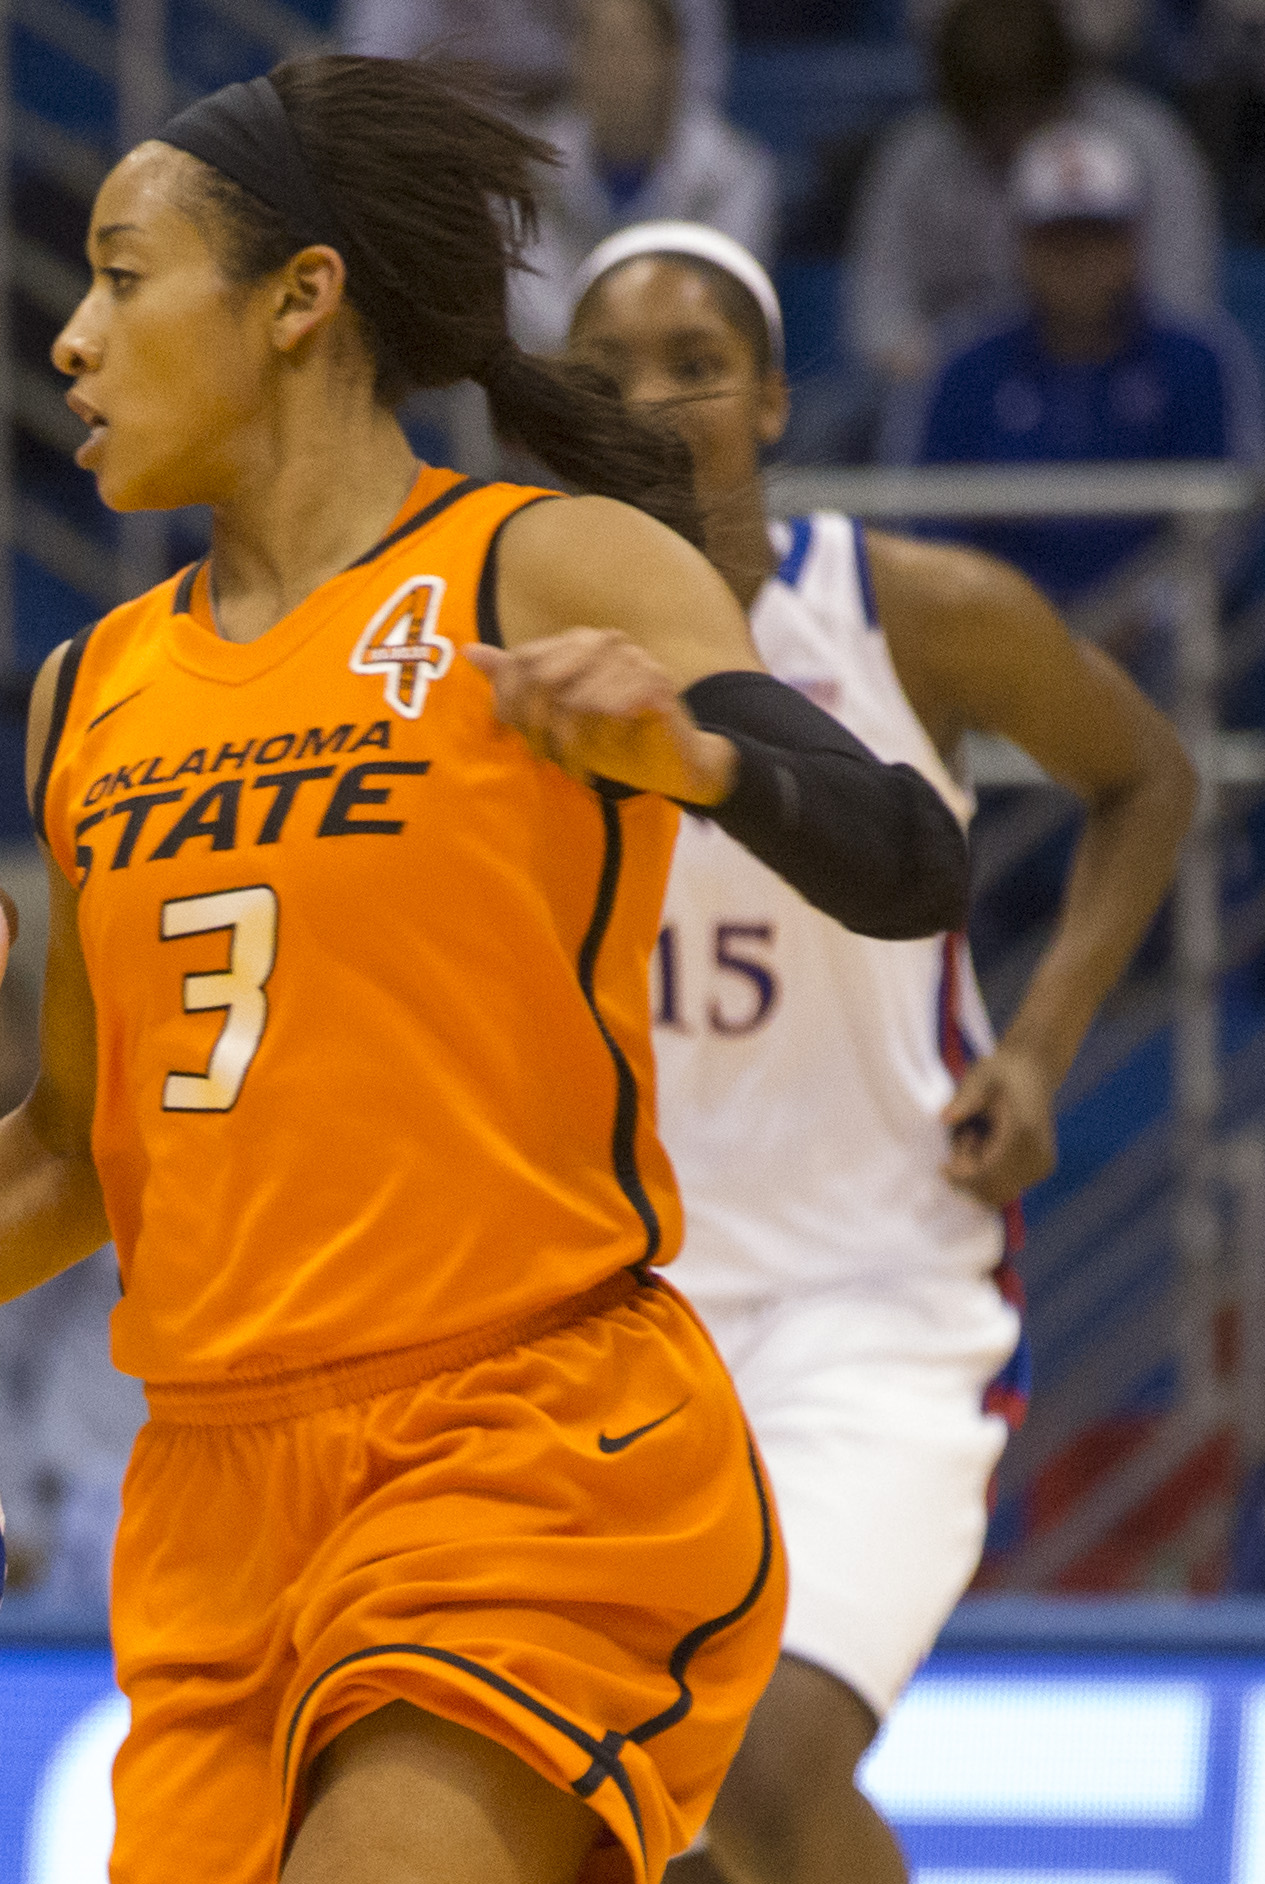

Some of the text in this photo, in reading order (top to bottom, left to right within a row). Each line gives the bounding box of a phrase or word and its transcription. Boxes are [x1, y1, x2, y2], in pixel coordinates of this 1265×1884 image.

[348, 574, 455, 720] 4
[81, 719, 393, 808] OKLAHOMA
[160, 883, 279, 1113] 3
[657, 920, 782, 1038] 15
